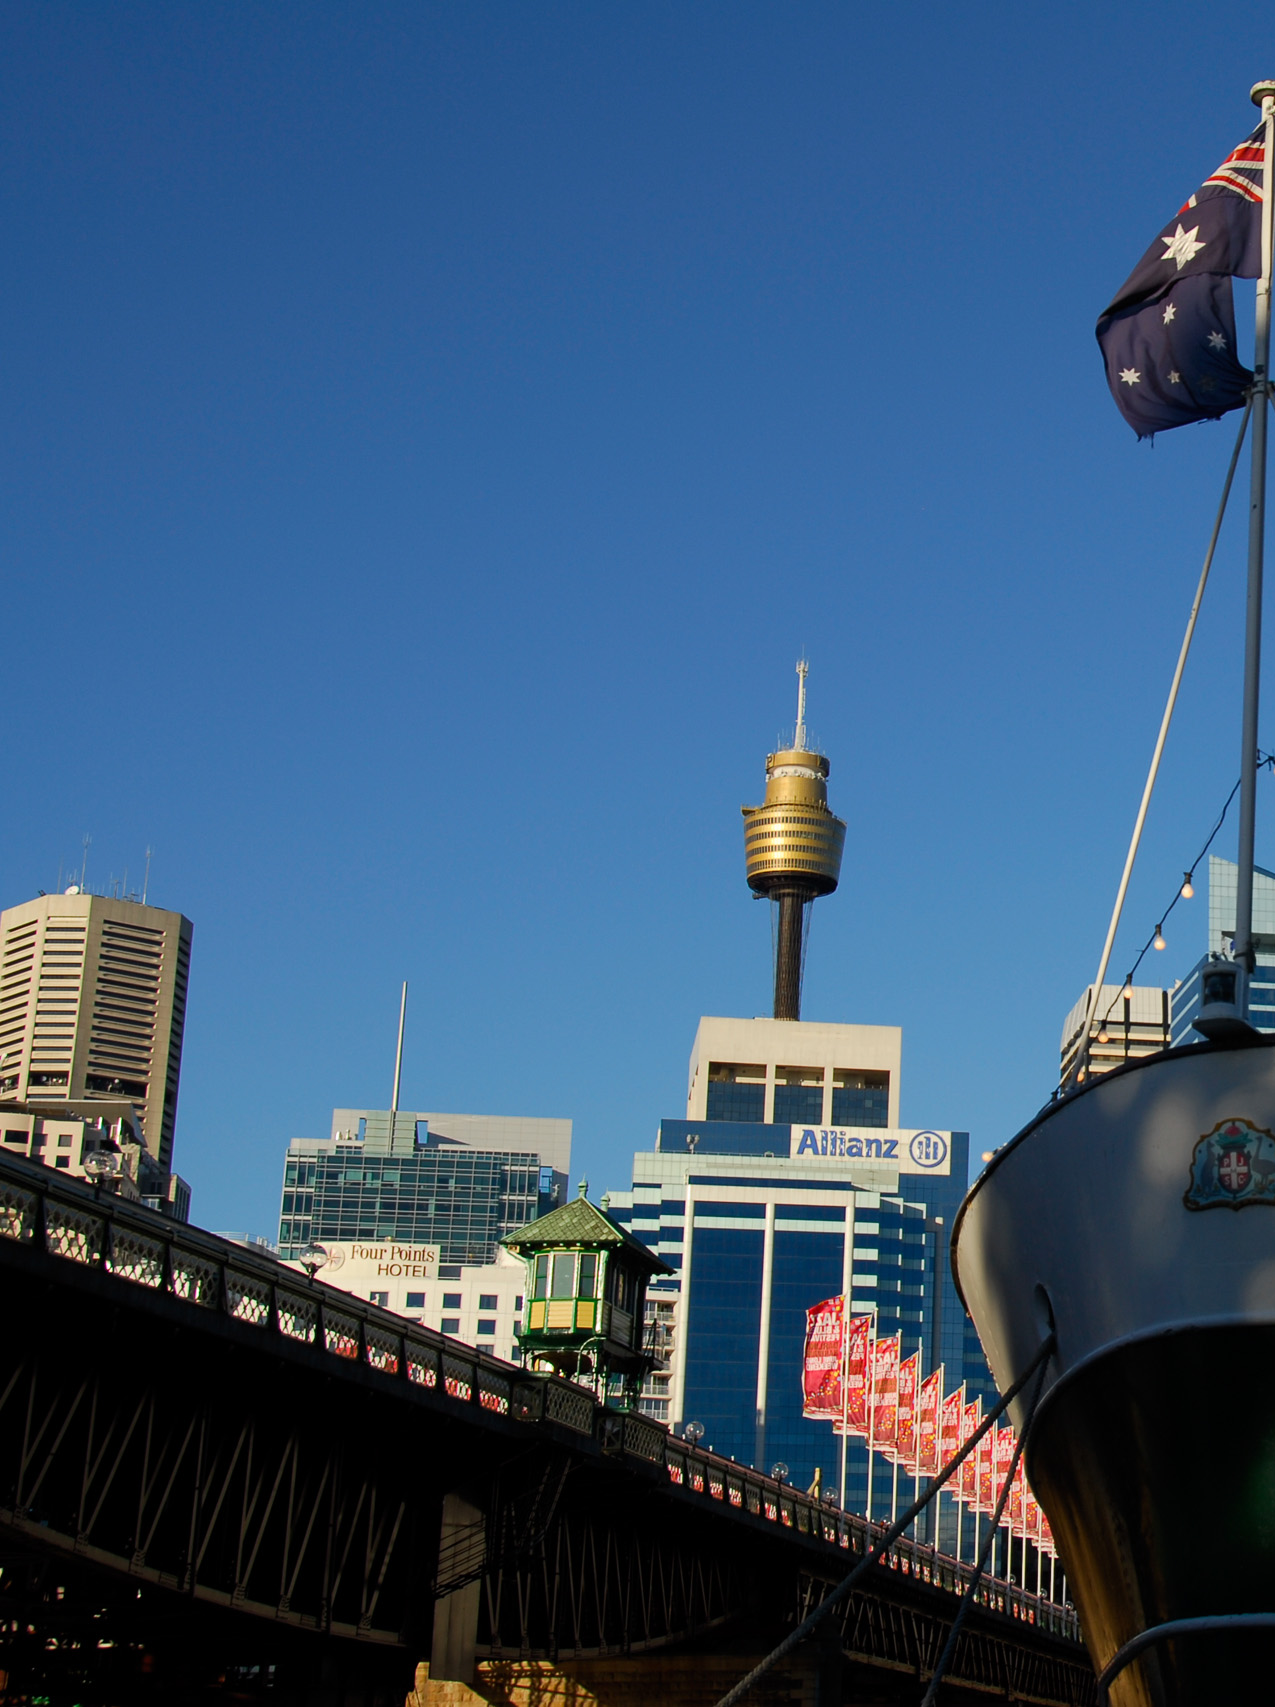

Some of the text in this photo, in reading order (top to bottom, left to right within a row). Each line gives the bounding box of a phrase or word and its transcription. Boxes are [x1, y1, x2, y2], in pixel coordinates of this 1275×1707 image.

[797, 1129, 898, 1159] Allianz
[351, 1245, 434, 1262] Four Points
[378, 1264, 431, 1278] HOTEL
